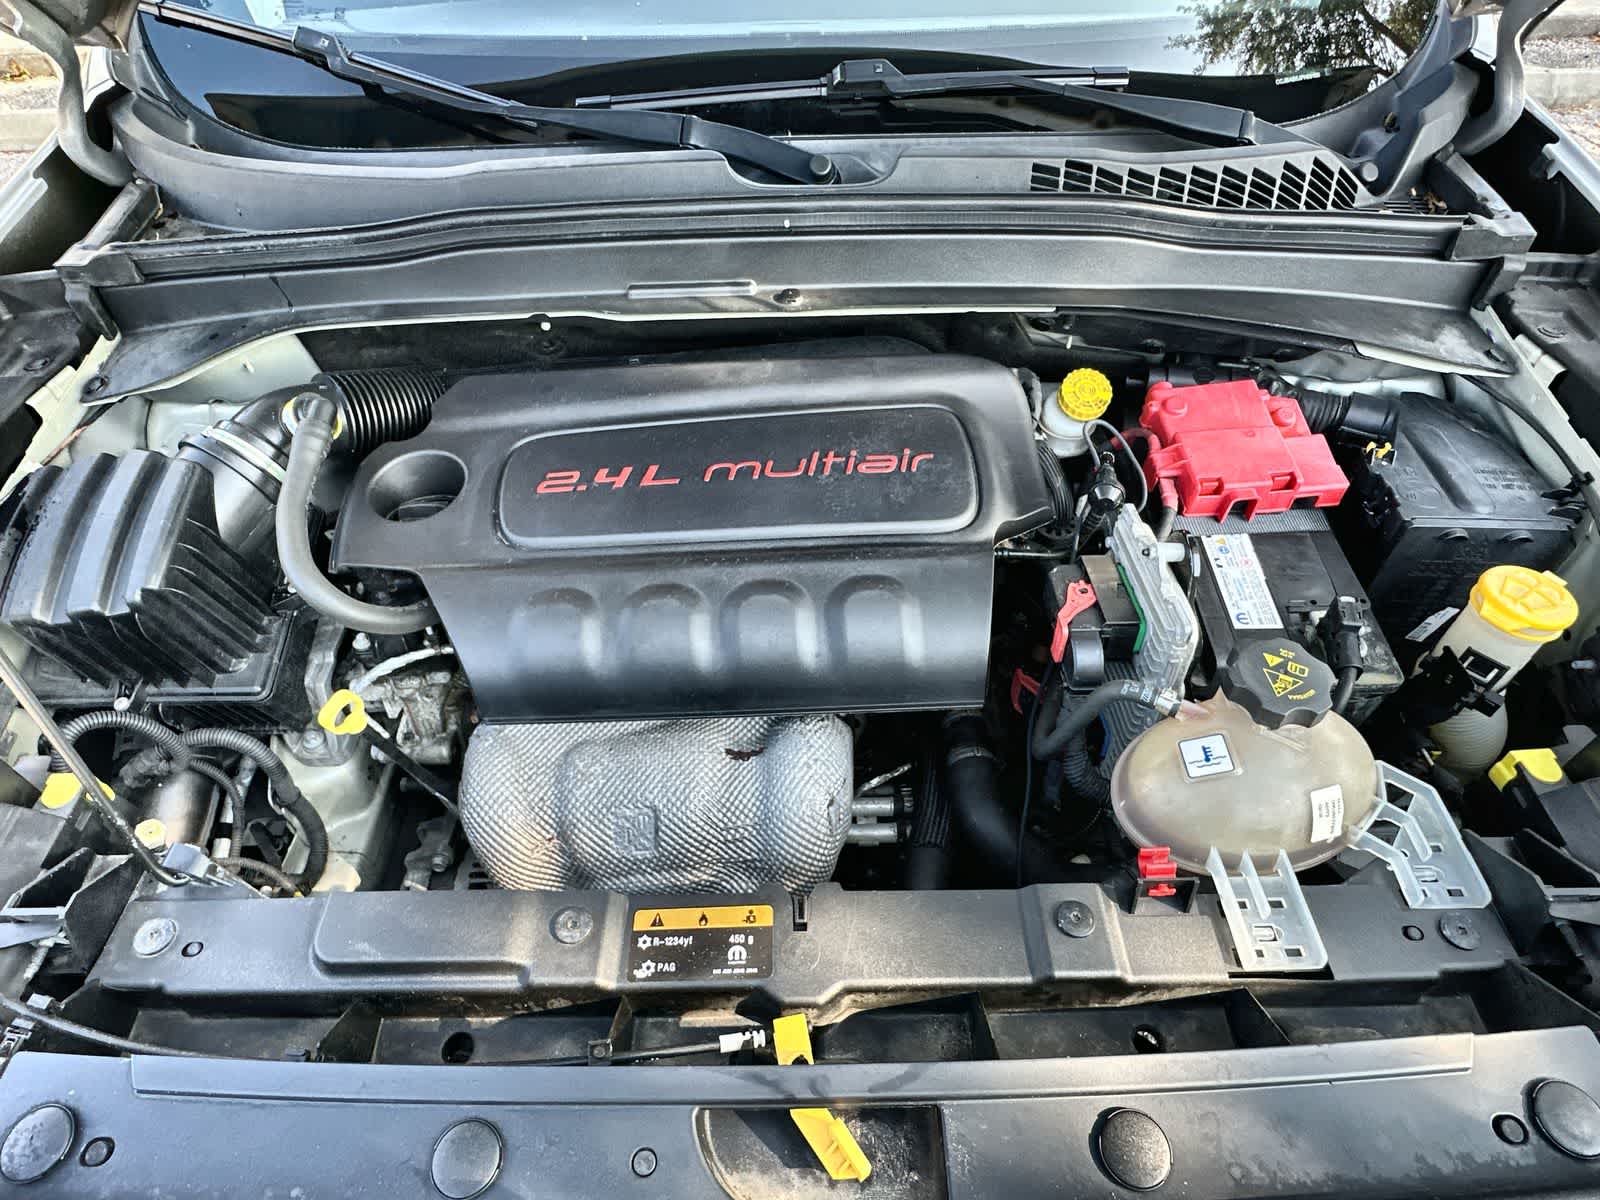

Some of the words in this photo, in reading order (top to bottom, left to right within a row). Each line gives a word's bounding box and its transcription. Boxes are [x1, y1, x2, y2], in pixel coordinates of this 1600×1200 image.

[653, 935, 693, 948] R-1234yf
[729, 934, 746, 944] 450
[657, 962, 677, 973] PAG
